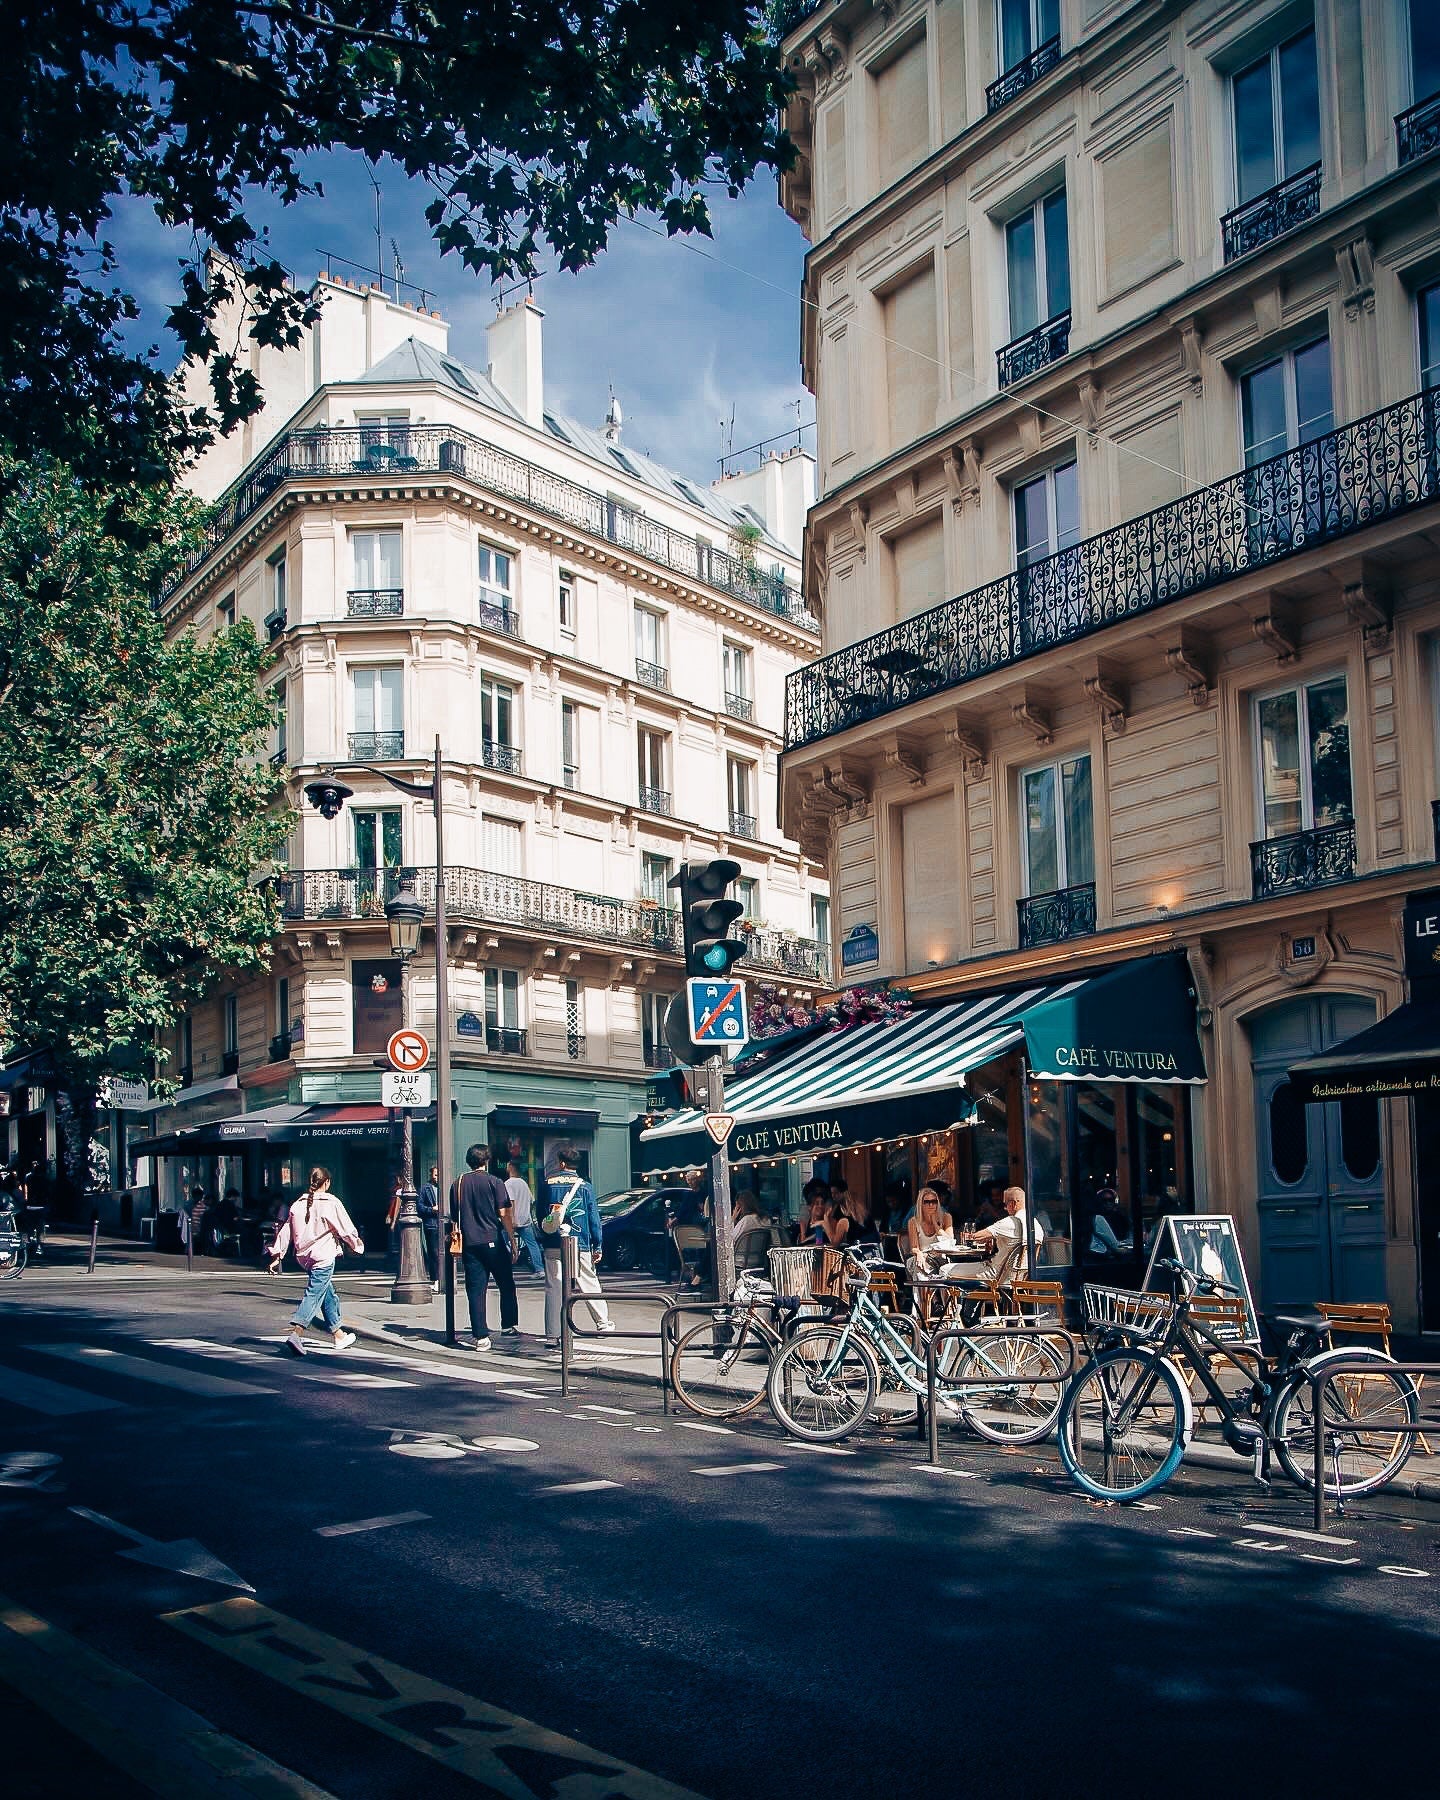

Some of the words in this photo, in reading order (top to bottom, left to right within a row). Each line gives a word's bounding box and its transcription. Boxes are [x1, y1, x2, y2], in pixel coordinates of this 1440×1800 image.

[1416, 917, 1438, 937] LE
[1294, 940, 1311, 956] 58
[727, 1023, 736, 1031] 20
[1056, 1045, 1099, 1067] CAFÉ
[1104, 1050, 1178, 1070] VENTURA
[393, 1075, 420, 1084] SAUF
[1312, 1082, 1363, 1097] Fabrication
[1366, 1076, 1412, 1092] artisanale
[1415, 1081, 1427, 1089] au
[312, 1128, 364, 1136] BOULANGERIE
[736, 1128, 770, 1152] CAFÉ
[774, 1120, 843, 1146] VENTURA
[1167, 1526, 1431, 1577] VELO
[180, 1610, 628, 1800] LIVRA
